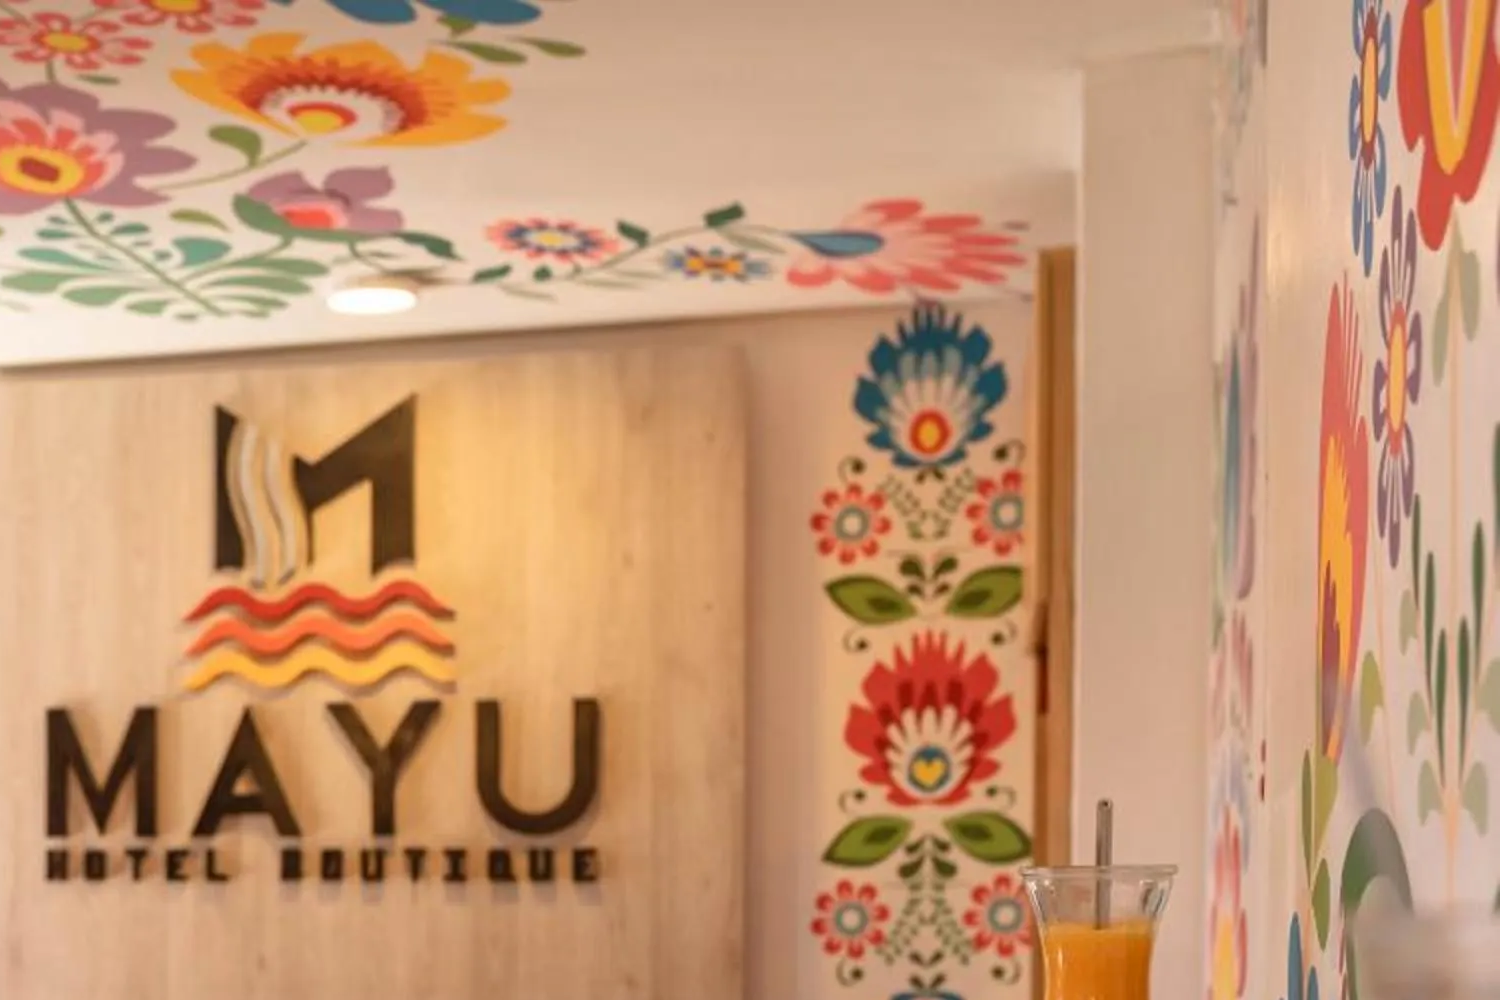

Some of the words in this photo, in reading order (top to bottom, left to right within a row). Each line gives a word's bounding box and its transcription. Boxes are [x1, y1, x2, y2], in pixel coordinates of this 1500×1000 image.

[45, 697, 599, 838] MAYU
[46, 848, 229, 882] HOTEL
[280, 847, 598, 882] BOUTIQUE
